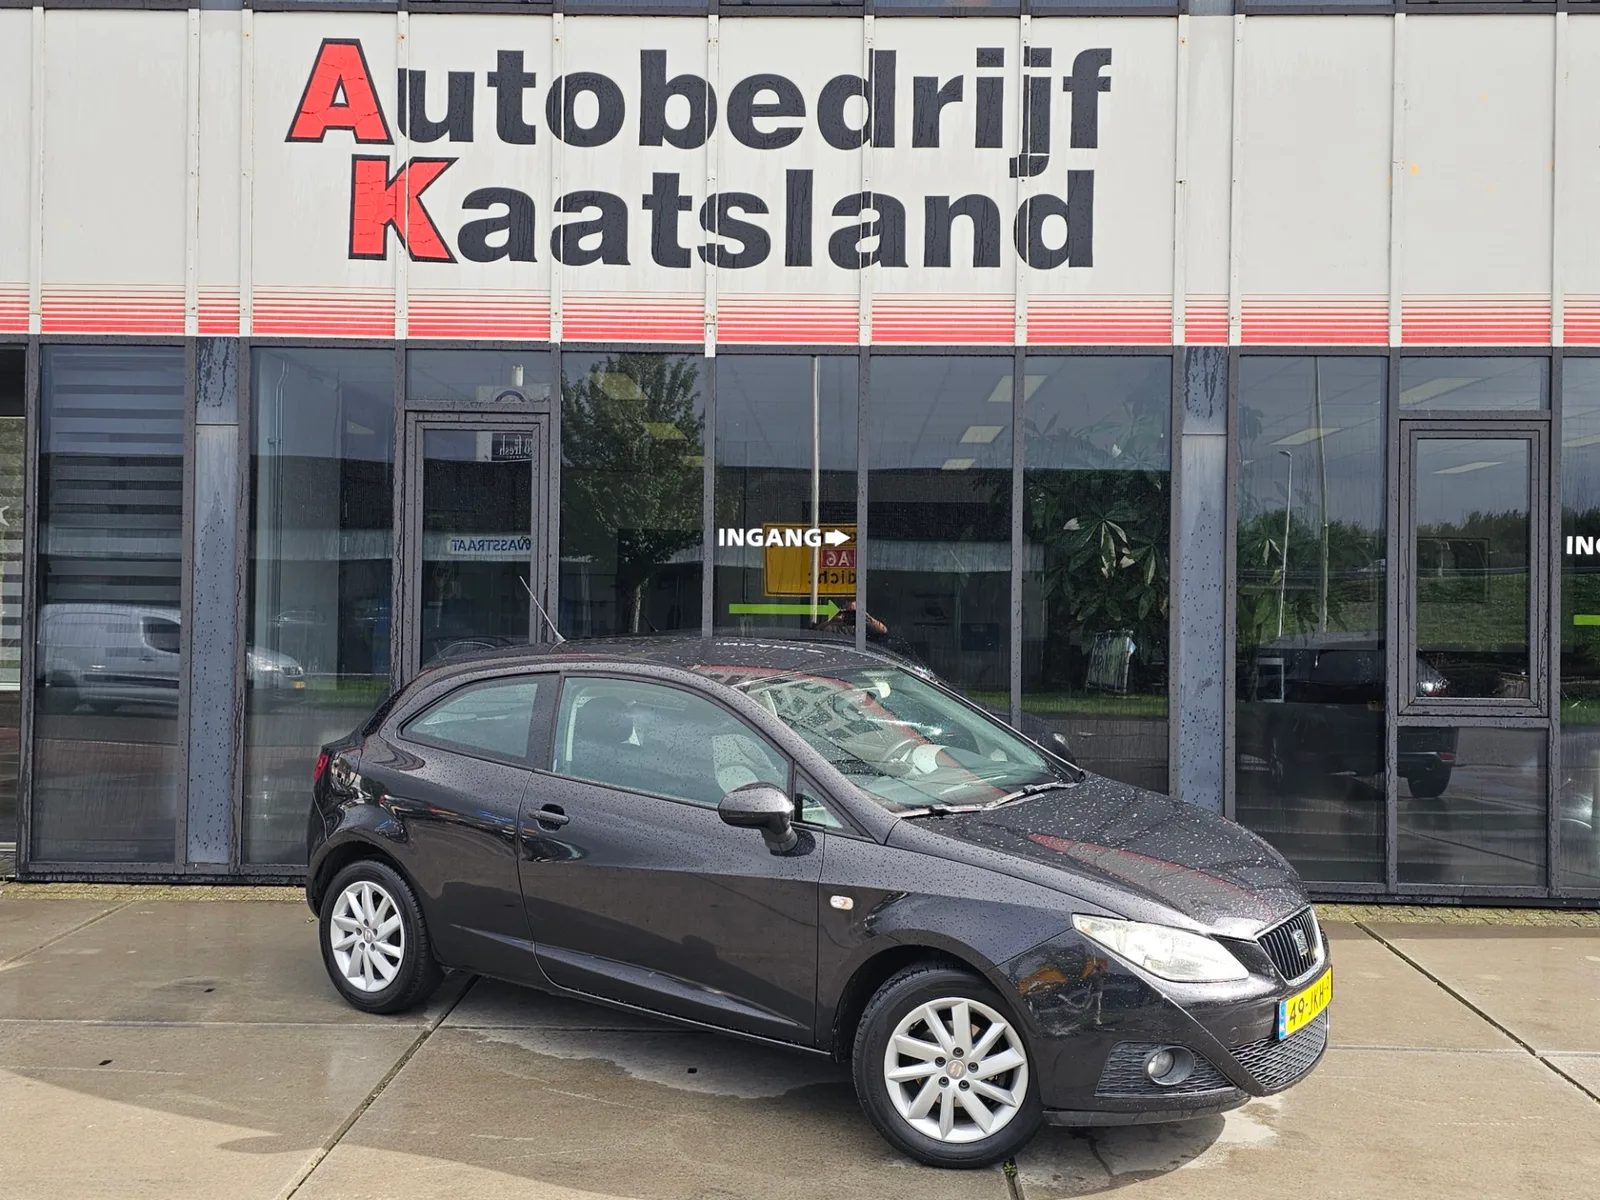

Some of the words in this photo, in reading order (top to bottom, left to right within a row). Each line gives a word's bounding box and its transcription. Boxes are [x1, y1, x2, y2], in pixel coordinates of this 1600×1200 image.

[284, 37, 1112, 179] Autobedrijf
[348, 155, 1094, 270] Kaatsland
[718, 528, 822, 547] INGANG
